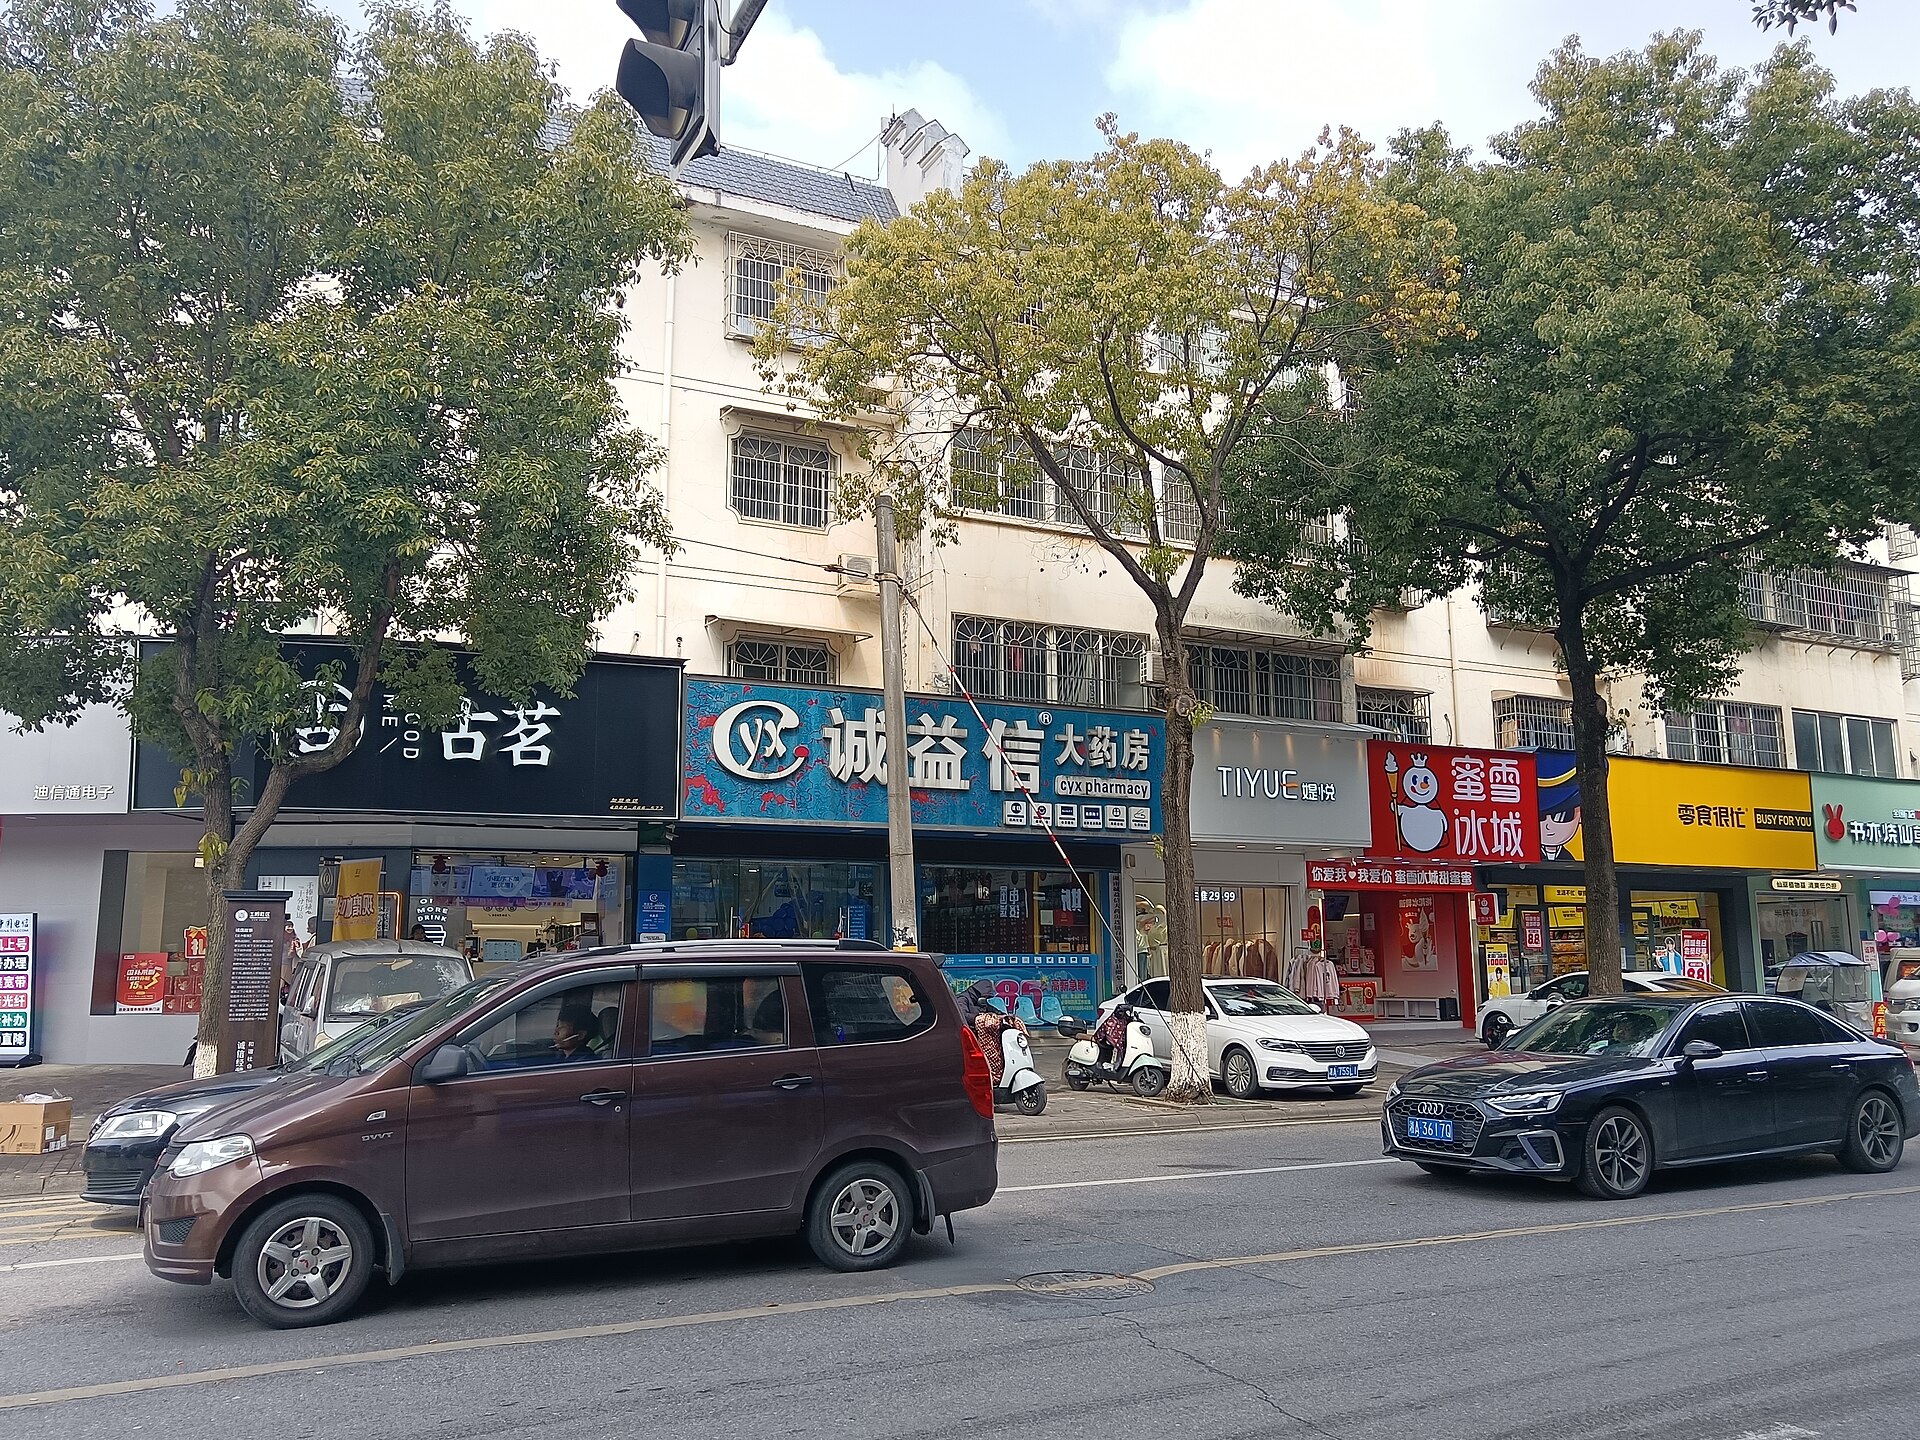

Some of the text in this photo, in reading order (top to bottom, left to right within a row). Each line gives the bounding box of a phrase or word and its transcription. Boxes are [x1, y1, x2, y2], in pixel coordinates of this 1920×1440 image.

[404, 697, 421, 758] OOD
[823, 707, 1045, 793] 诚益信
[1055, 722, 1151, 771] 大药房
[1060, 779, 1148, 798] cyx pharmacy
[1217, 765, 1299, 800] TIYUE
[1451, 754, 1521, 803] 蜜雪
[33, 784, 114, 801] 迪信通电子
[1677, 803, 1746, 829] 零食很忙
[1756, 813, 1812, 827] BUSY FOR YOU
[1453, 808, 1524, 857] 冰城
[1395, 869, 1473, 886] 蜜雪冰城甜蜜蜜
[416, 906, 449, 914] MORE
[417, 914, 447, 922] DRINK
[361, 1131, 394, 1142] DVVT
